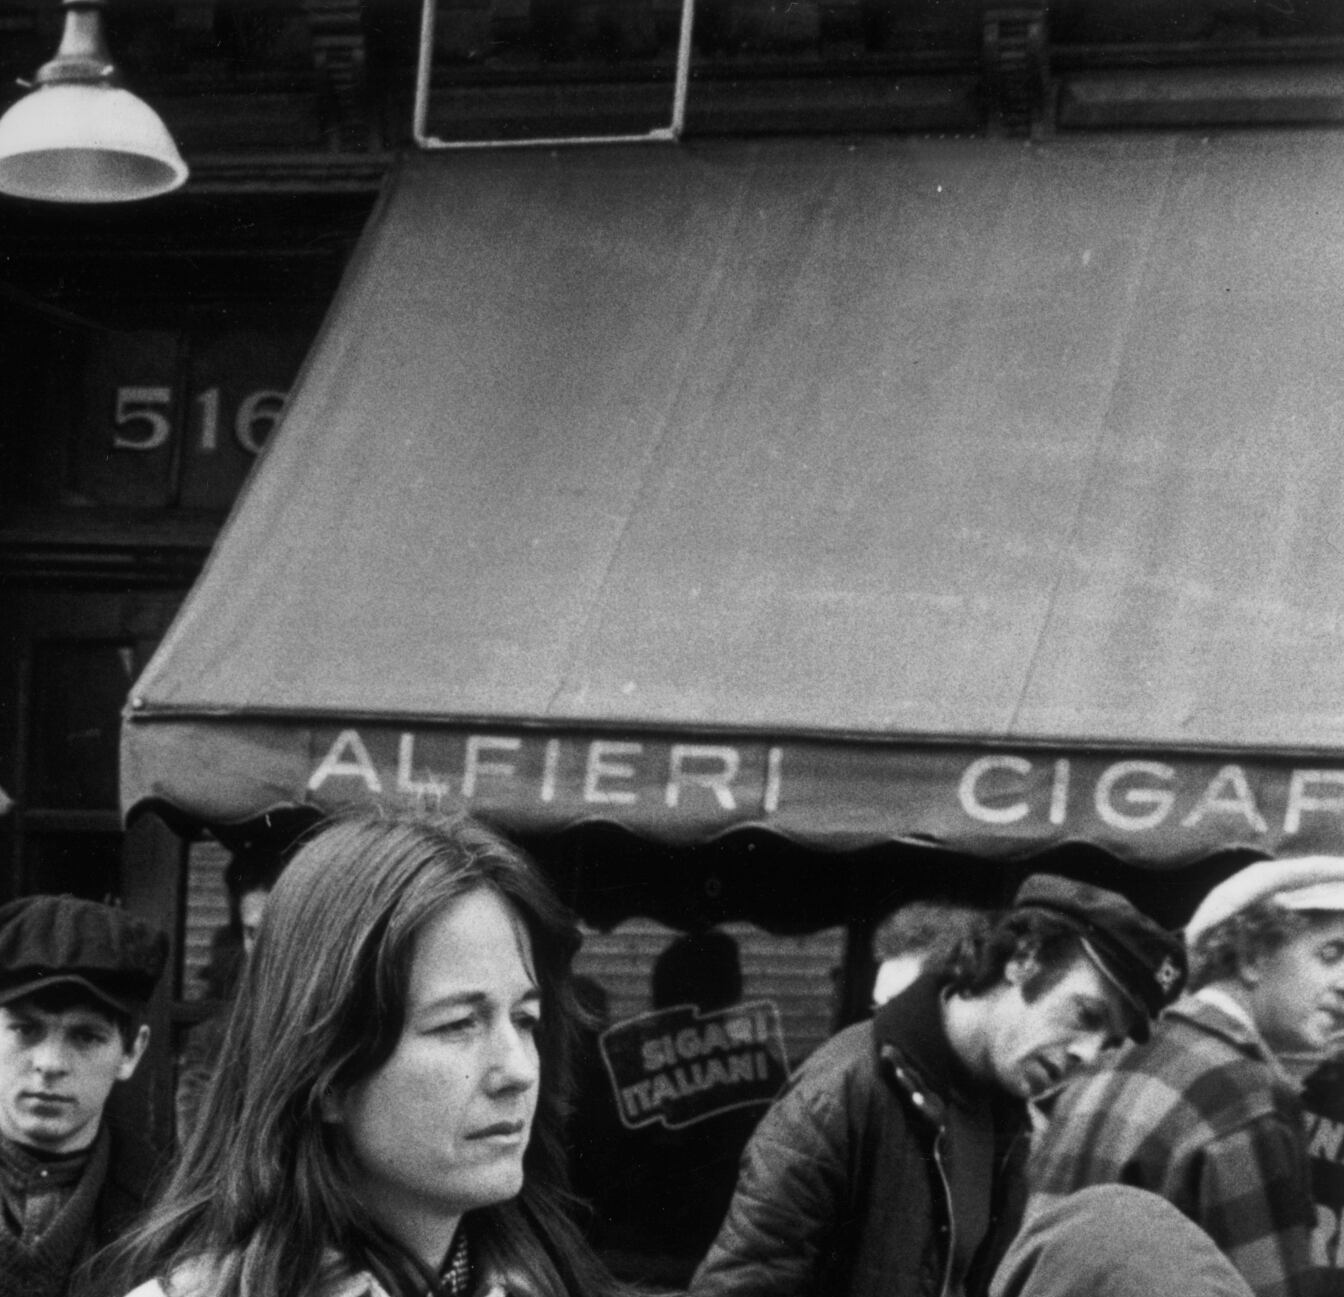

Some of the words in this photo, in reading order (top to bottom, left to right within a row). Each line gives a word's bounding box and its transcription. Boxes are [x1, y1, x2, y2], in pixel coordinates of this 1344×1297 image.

[113, 386, 289, 455] 516
[307, 729, 784, 813] ALFIERI
[621, 1051, 769, 1117] ITALIANI
